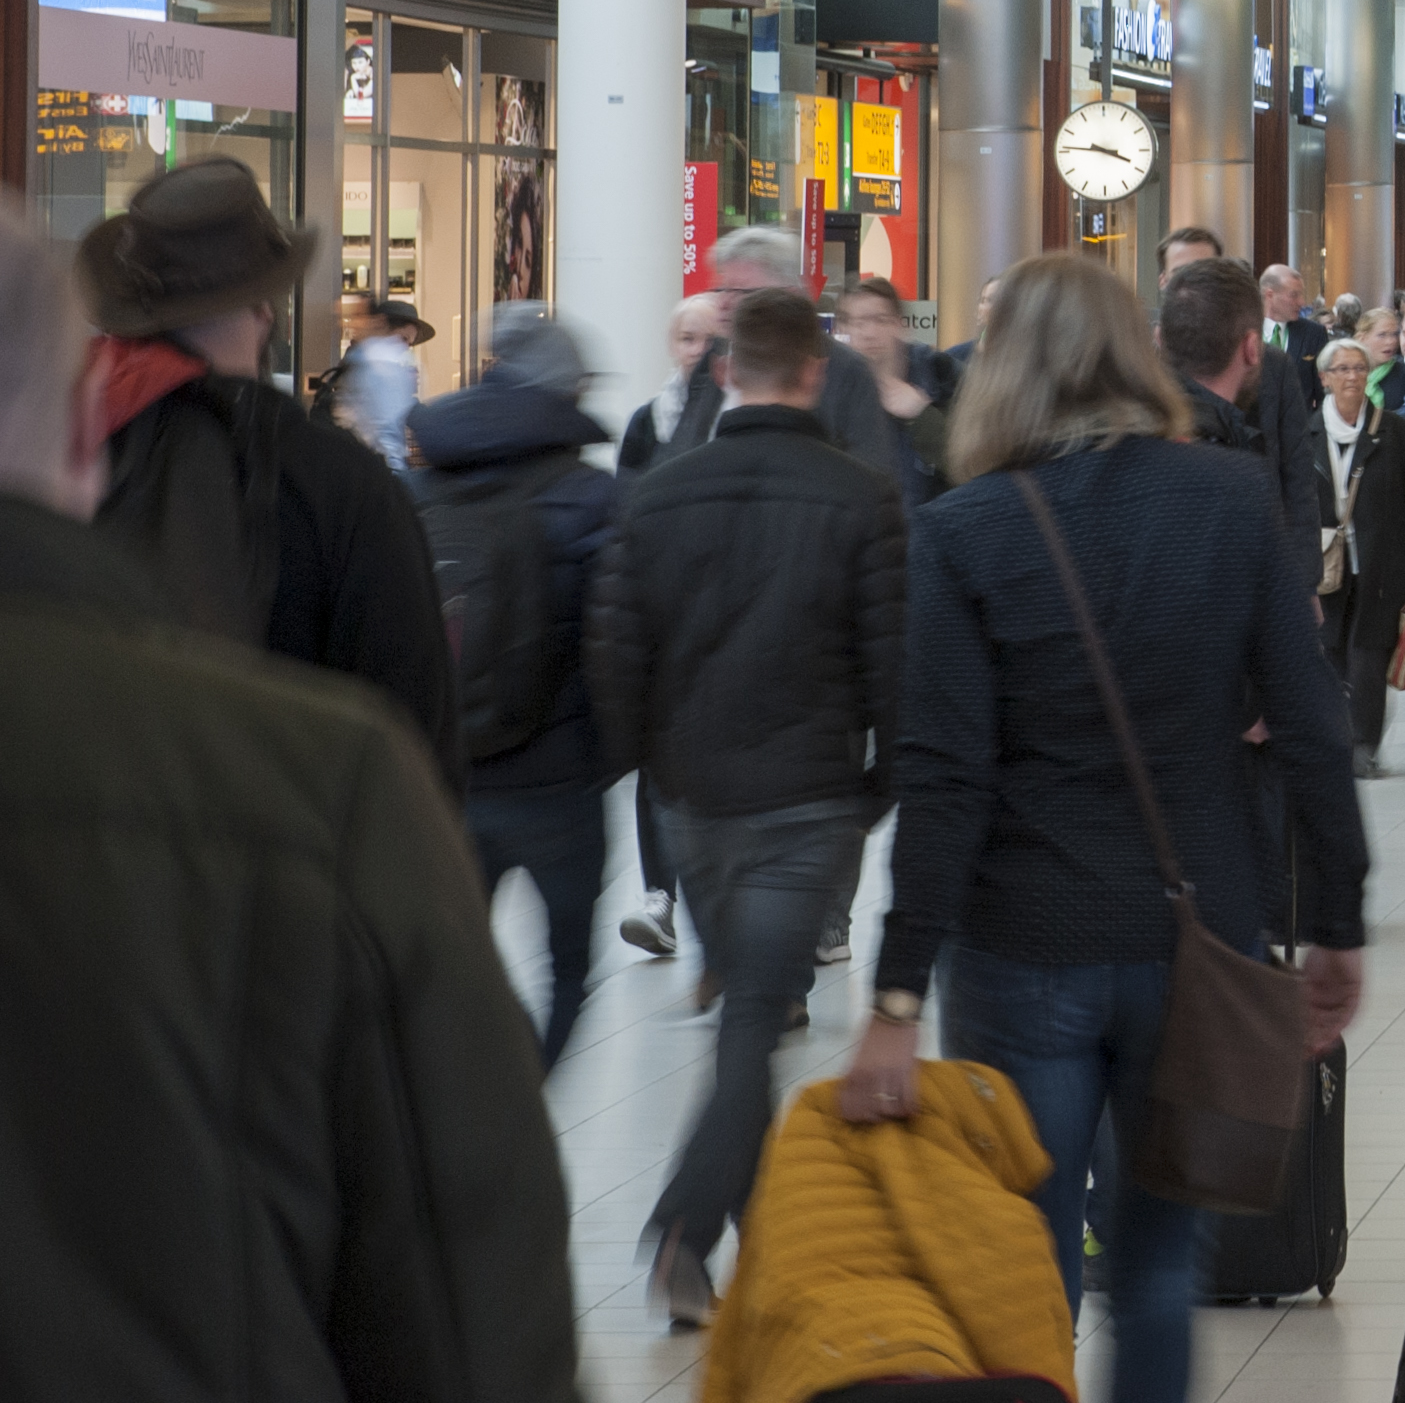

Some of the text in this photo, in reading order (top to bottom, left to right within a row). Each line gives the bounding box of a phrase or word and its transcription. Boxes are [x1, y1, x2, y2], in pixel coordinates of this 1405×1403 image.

[1114, 6, 1147, 56] FASHION
[683, 165, 697, 276] Save up to 50%
